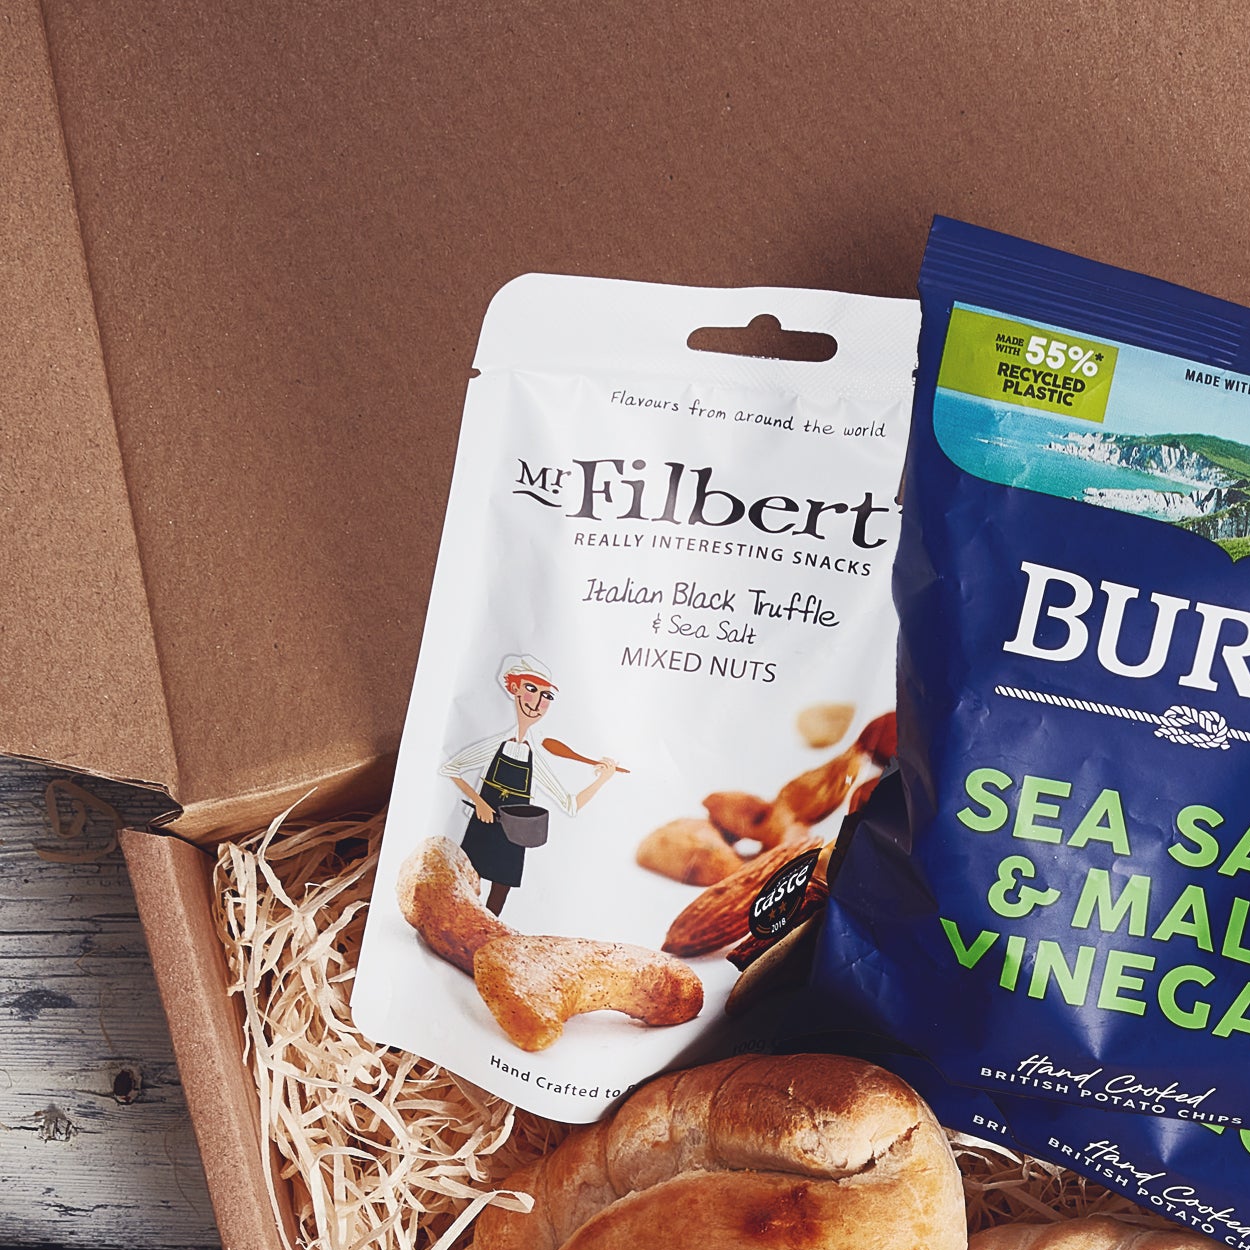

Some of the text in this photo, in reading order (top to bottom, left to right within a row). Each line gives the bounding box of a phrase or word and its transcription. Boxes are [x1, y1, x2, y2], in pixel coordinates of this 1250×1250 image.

[996, 334, 1024, 346] MADE
[996, 343, 1020, 356] WITH
[997, 362, 1086, 393] RECYCLED
[1002, 379, 1075, 406] PLASTIC
[1184, 368, 1223, 389] MADE
[611, 390, 886, 438] Flavours from around the world
[566, 459, 902, 549] Filbert
[574, 533, 871, 576] REALLY INTERESTING SNACKS
[582, 578, 840, 627] Italian Black Truffle
[652, 612, 757, 645] & Sea Salt
[621, 647, 777, 683] MIXED NUTS
[956, 767, 1131, 856] SEA
[987, 855, 1060, 918] &
[490, 1055, 530, 1082] Hand
[536, 1077, 598, 1098] Crafted
[605, 1088, 621, 1099] to
[980, 1067, 1242, 1125] BRITISH POTATO CHIPS
[1017, 1054, 1216, 1108] Hand Cooked
[1048, 1137, 1129, 1187] BRITISH
[1137, 1187, 1215, 1234] POTATO
[1084, 1140, 1166, 1186] Hand
